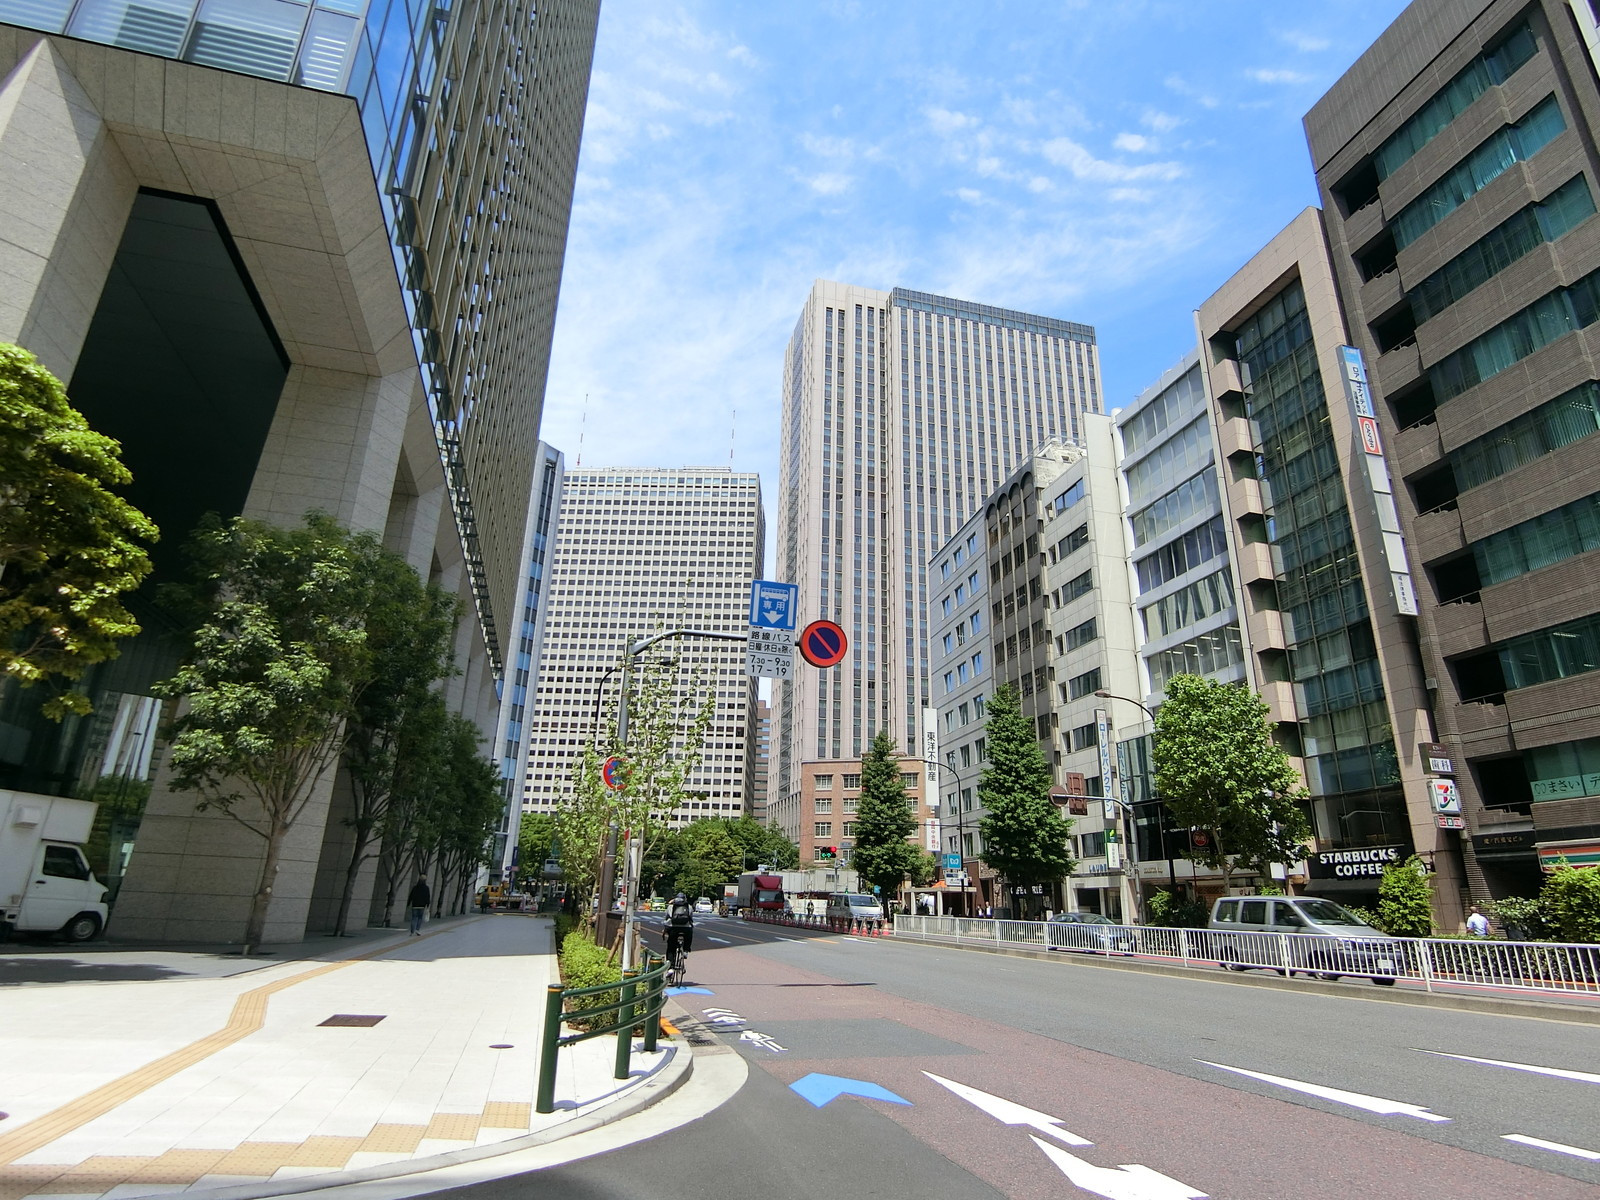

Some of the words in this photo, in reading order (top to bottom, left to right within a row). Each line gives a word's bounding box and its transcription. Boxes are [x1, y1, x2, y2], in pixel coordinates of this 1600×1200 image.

[763, 600, 785, 611] 専用
[751, 631, 791, 643] 路線バス
[926, 731, 937, 782] 東洋不動産
[1319, 848, 1397, 864] STARBUCKS
[1335, 862, 1384, 877] COFFEE
